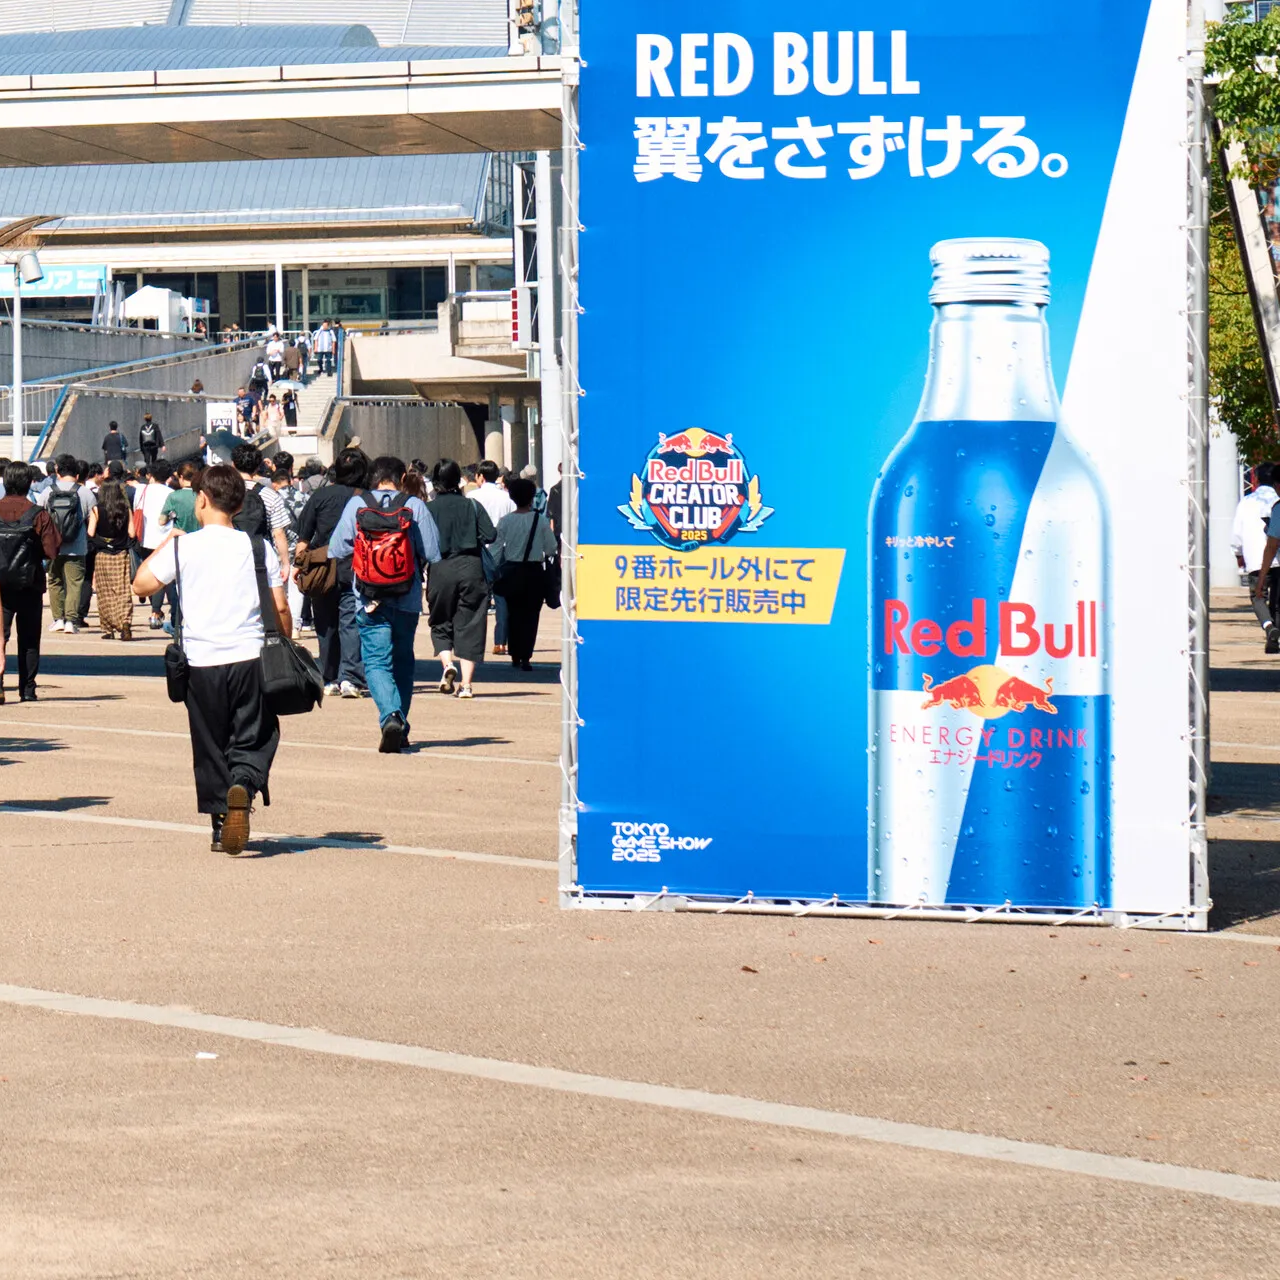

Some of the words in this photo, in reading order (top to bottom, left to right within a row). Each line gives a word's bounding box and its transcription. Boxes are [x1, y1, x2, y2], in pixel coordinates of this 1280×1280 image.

[635, 33, 754, 97] RED
[773, 30, 920, 95] BULL
[633, 115, 1069, 183] 翼をさずける。
[212, 418, 232, 426] TAXI
[649, 459, 695, 482] Red
[697, 460, 742, 483] Bull
[649, 483, 741, 506] CREATOR
[669, 506, 722, 530] CLUB
[681, 530, 708, 541] 2025
[885, 535, 956, 548] キリッと冷やして
[615, 554, 816, 582] 9番ホール外にて
[615, 586, 807, 615] 限定先行販売中
[884, 598, 987, 658] Red
[999, 600, 1097, 659] Bull
[890, 724, 995, 747] ENERGY
[1008, 727, 1089, 749] DRINK
[929, 749, 1043, 768] エナジードリンク
[611, 822, 670, 836] TOKYO
[611, 834, 657, 849] GAME
[658, 836, 713, 850] SHOW
[611, 848, 661, 862] 2025
